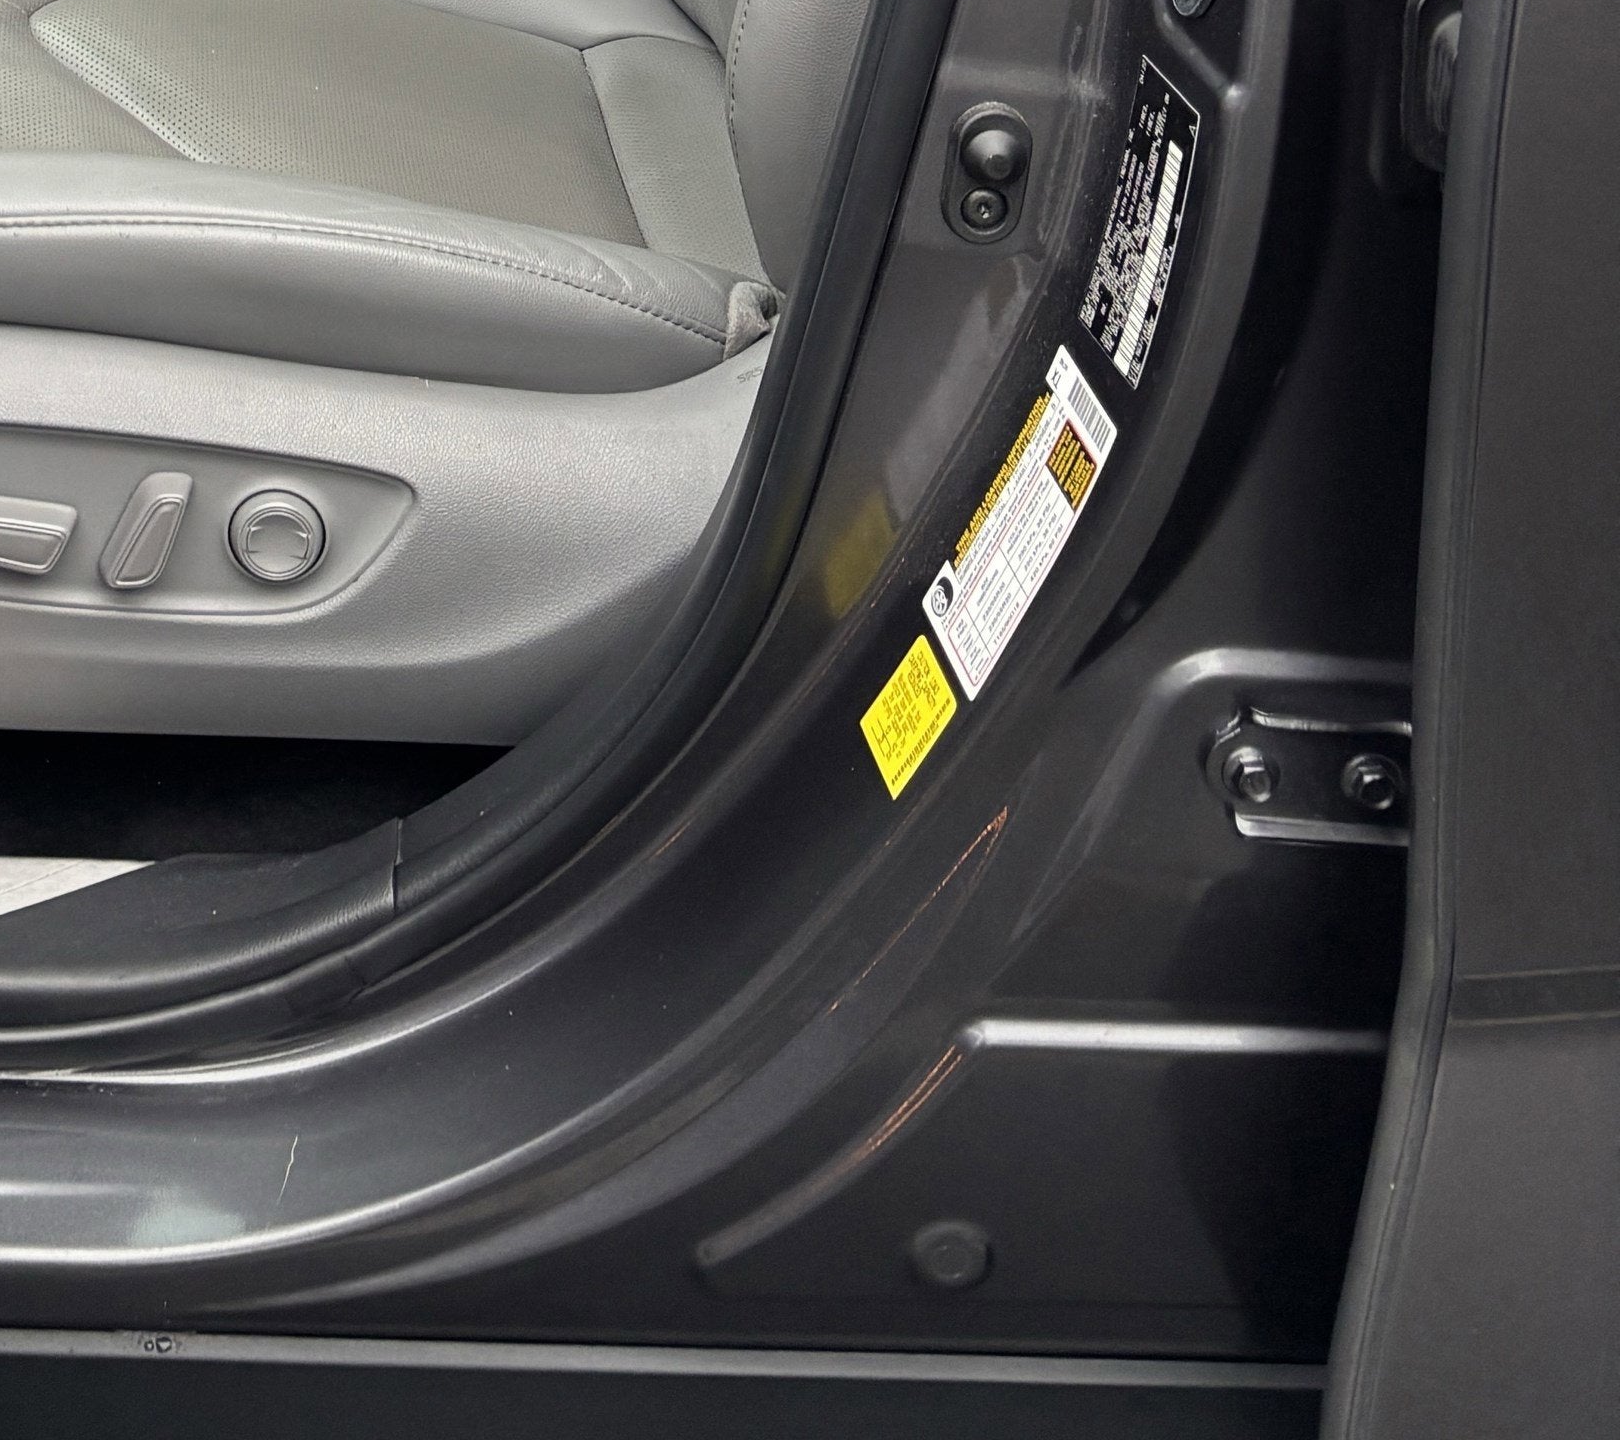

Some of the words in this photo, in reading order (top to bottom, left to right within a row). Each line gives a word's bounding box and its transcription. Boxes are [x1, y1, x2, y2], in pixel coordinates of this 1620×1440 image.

[954, 526, 970, 554] TIRE
[968, 504, 983, 530] AND
[980, 461, 1008, 508] LOADING
[1004, 393, 1044, 465] INFORMATION
